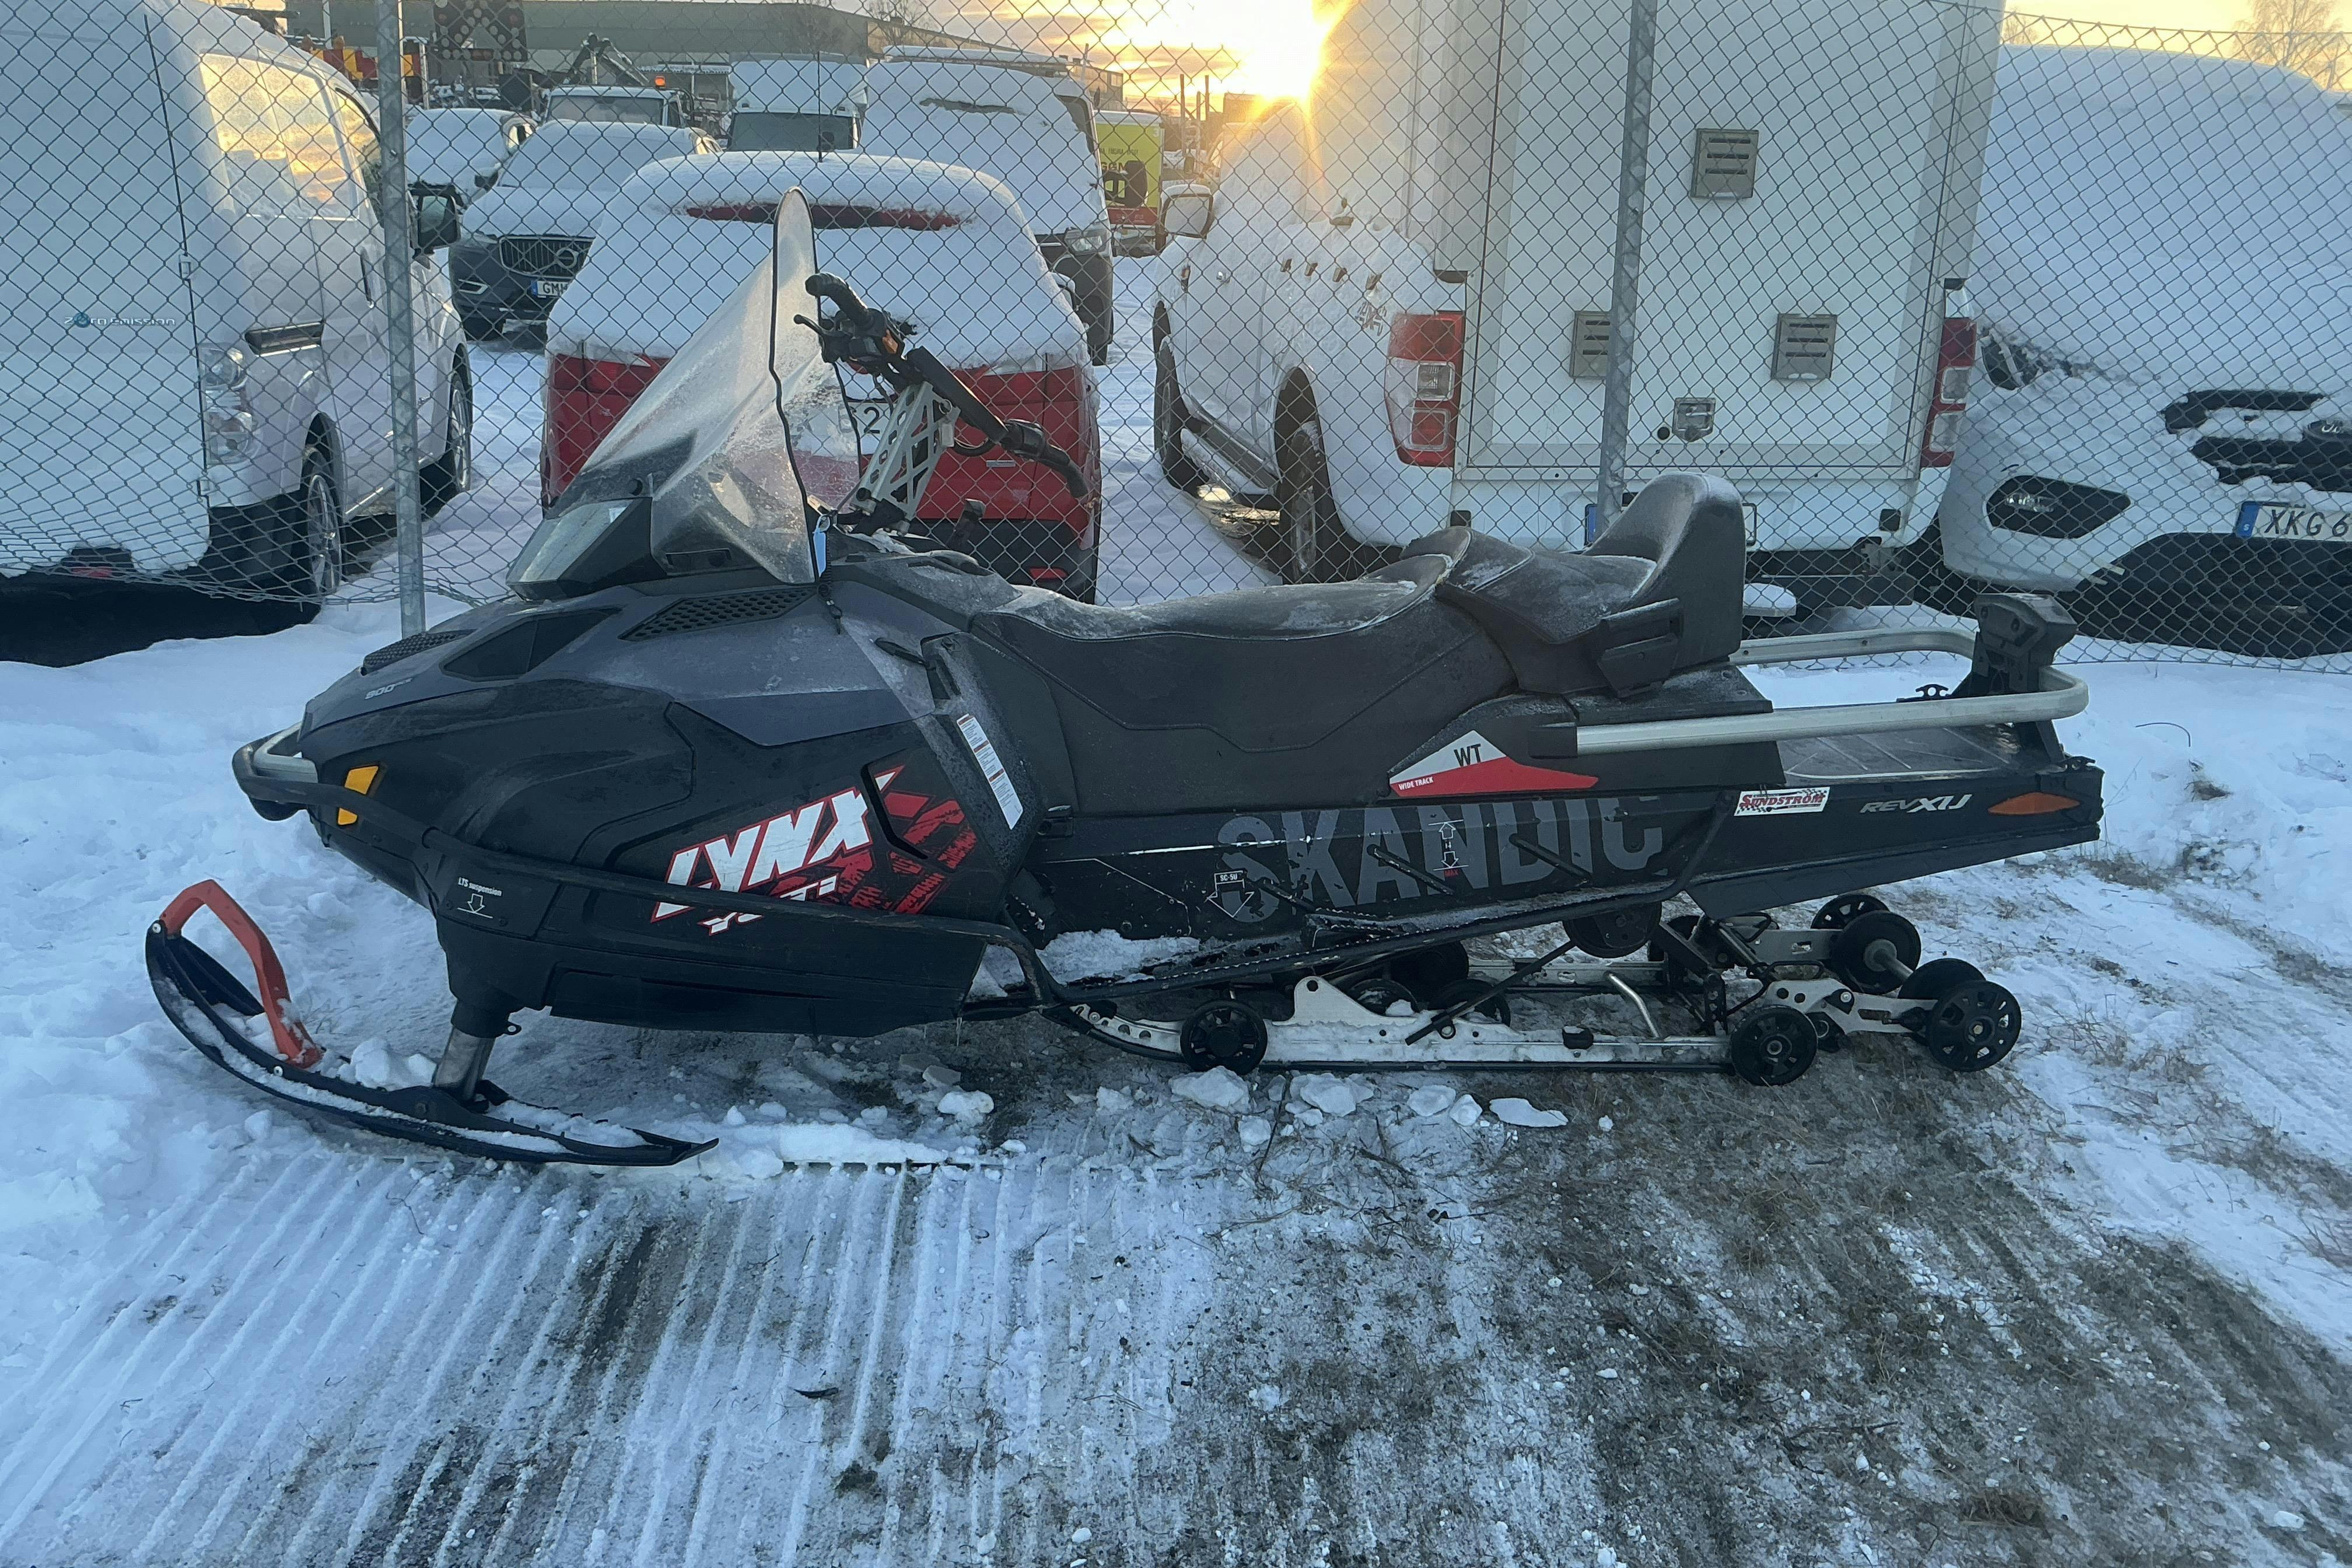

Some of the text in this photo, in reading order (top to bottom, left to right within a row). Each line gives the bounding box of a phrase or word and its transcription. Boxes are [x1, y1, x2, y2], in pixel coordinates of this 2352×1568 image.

[2264, 509, 2325, 536] XKG
[1453, 743, 1481, 767] WT
[1398, 776, 1434, 790] WIDE TRACK
[652, 787, 873, 923] LYNX
[1218, 799, 1662, 923] SKANDIC
[458, 877, 502, 897] LTS suspension
